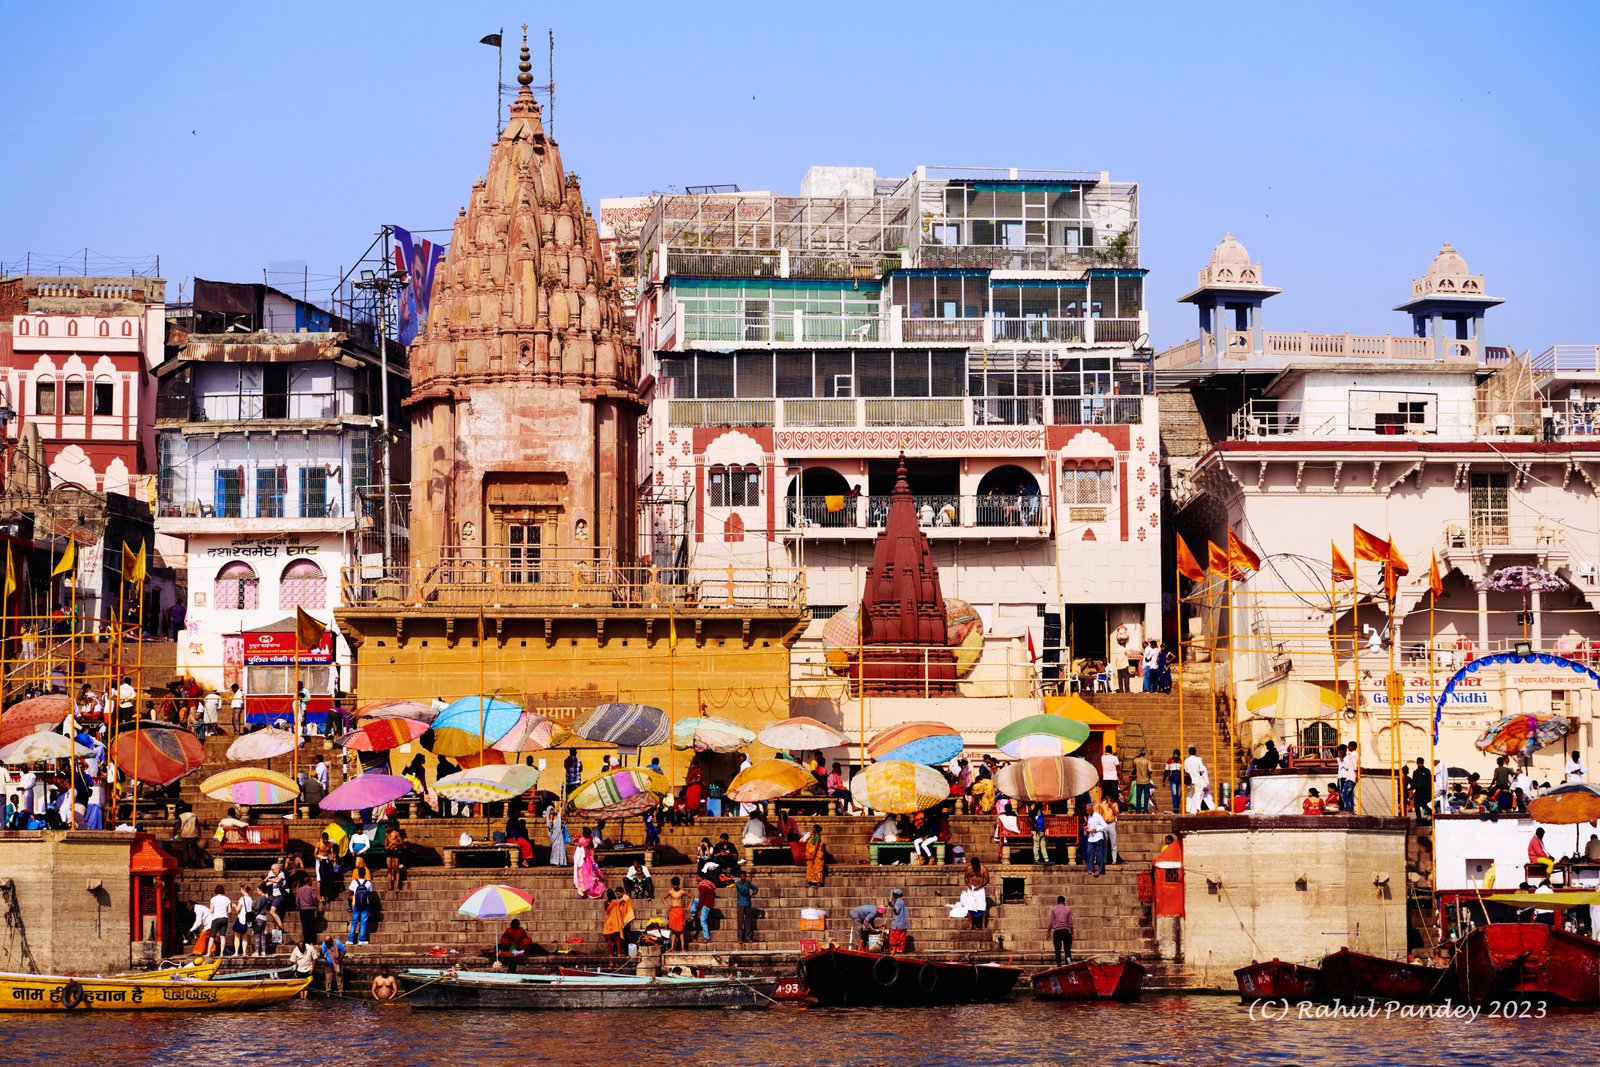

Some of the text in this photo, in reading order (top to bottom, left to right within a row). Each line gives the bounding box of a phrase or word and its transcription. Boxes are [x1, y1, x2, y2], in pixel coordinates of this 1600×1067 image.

[207, 545, 319, 558] दशाश्वमेध घाट
[247, 655, 268, 664] पुलिस
[1416, 693, 1448, 704] Sev
[1452, 692, 1488, 703] Nidhi
[12, 987, 45, 1001] नाम
[131, 986, 144, 1003] है
